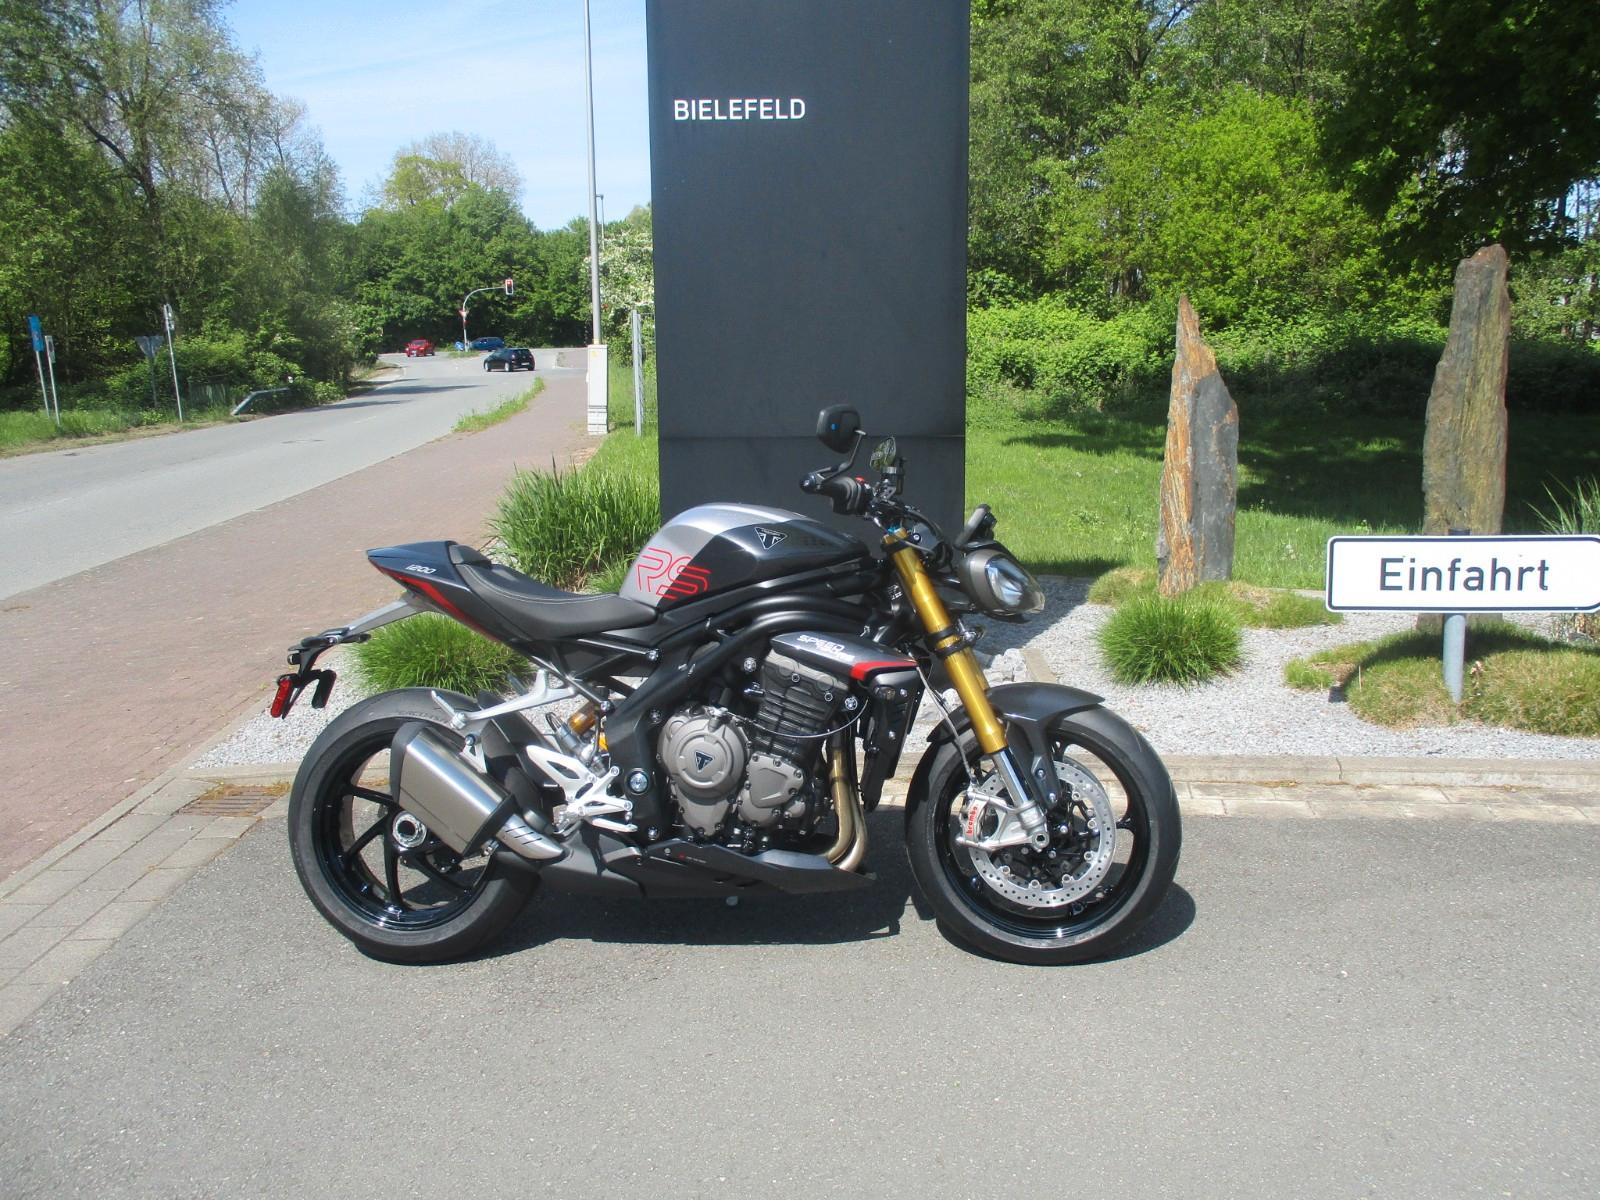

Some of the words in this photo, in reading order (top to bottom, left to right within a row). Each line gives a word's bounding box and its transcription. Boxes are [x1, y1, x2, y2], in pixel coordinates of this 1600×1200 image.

[674, 98, 806, 120] BIELEFELD
[405, 565, 436, 574] 1200
[636, 547, 711, 600] RS
[1379, 558, 1550, 591] Einfahrt
[797, 634, 845, 652] SPEED
[966, 805, 978, 834] brembo
